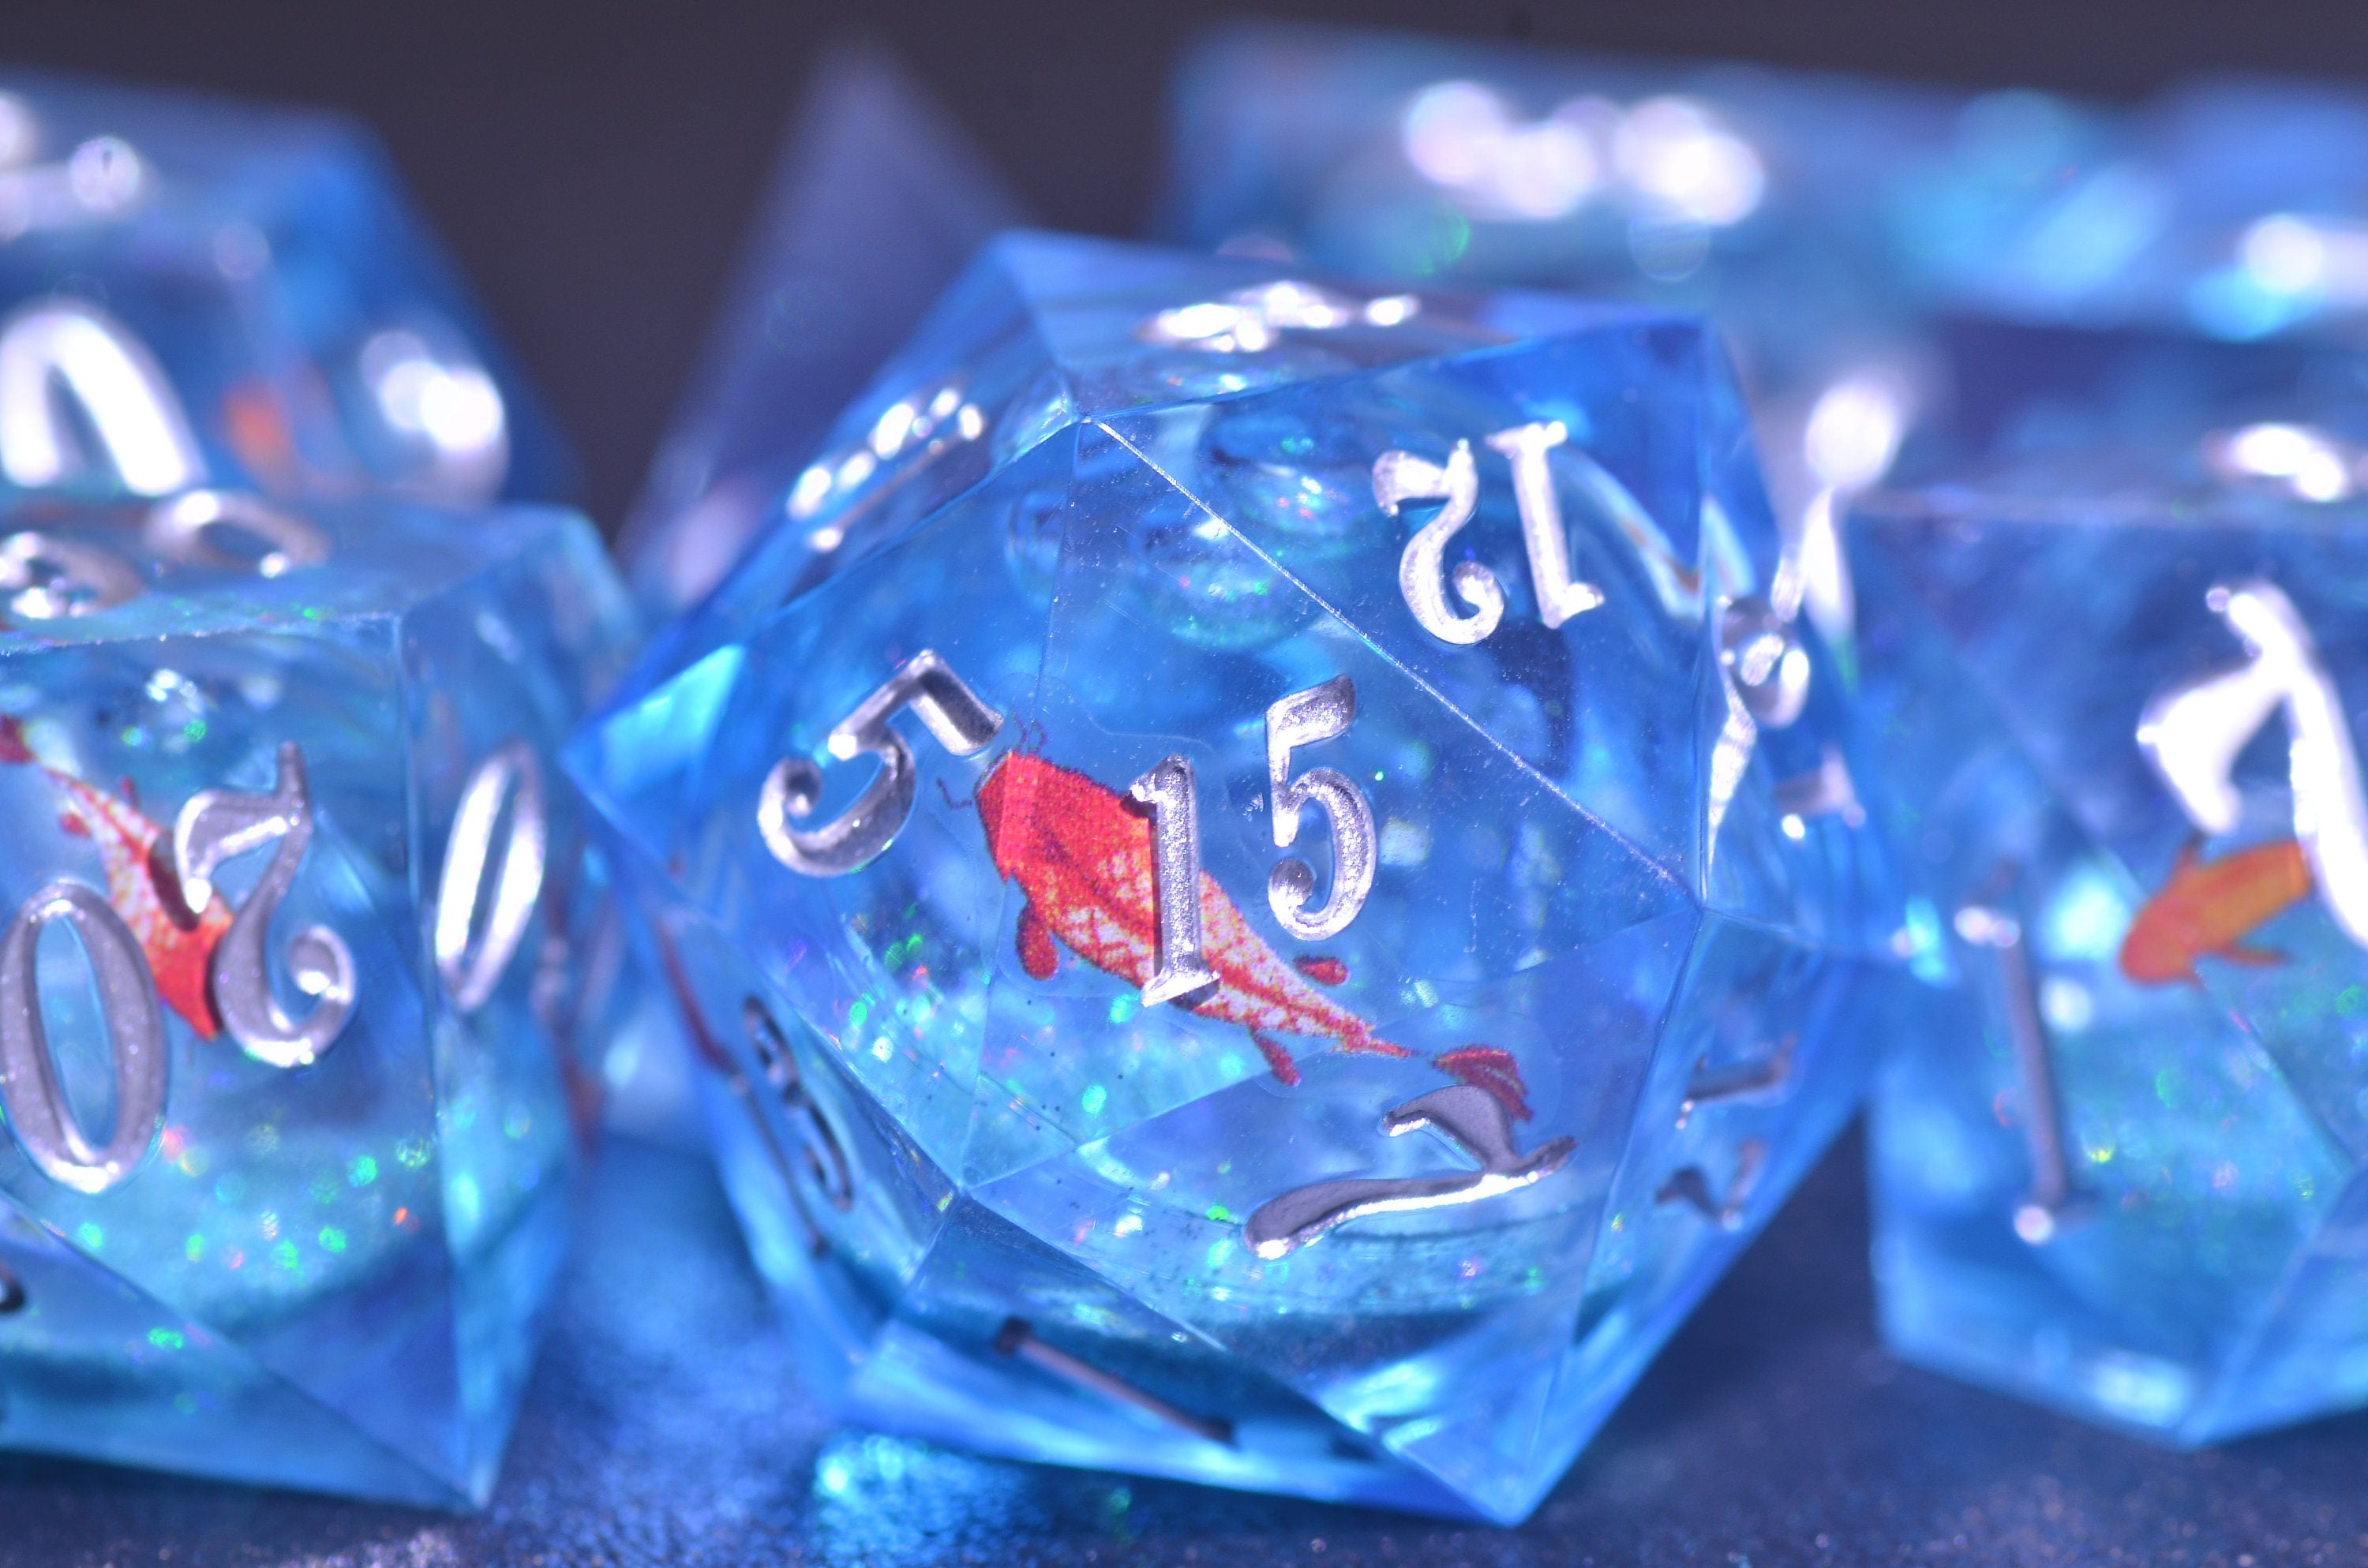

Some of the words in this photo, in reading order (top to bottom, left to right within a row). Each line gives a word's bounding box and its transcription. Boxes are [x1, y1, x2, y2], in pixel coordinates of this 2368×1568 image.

[1371, 420, 1605, 646] 12
[756, 649, 1005, 878] 5
[1129, 675, 1377, 1007] 15
[1242, 1084, 1576, 1262] 7
